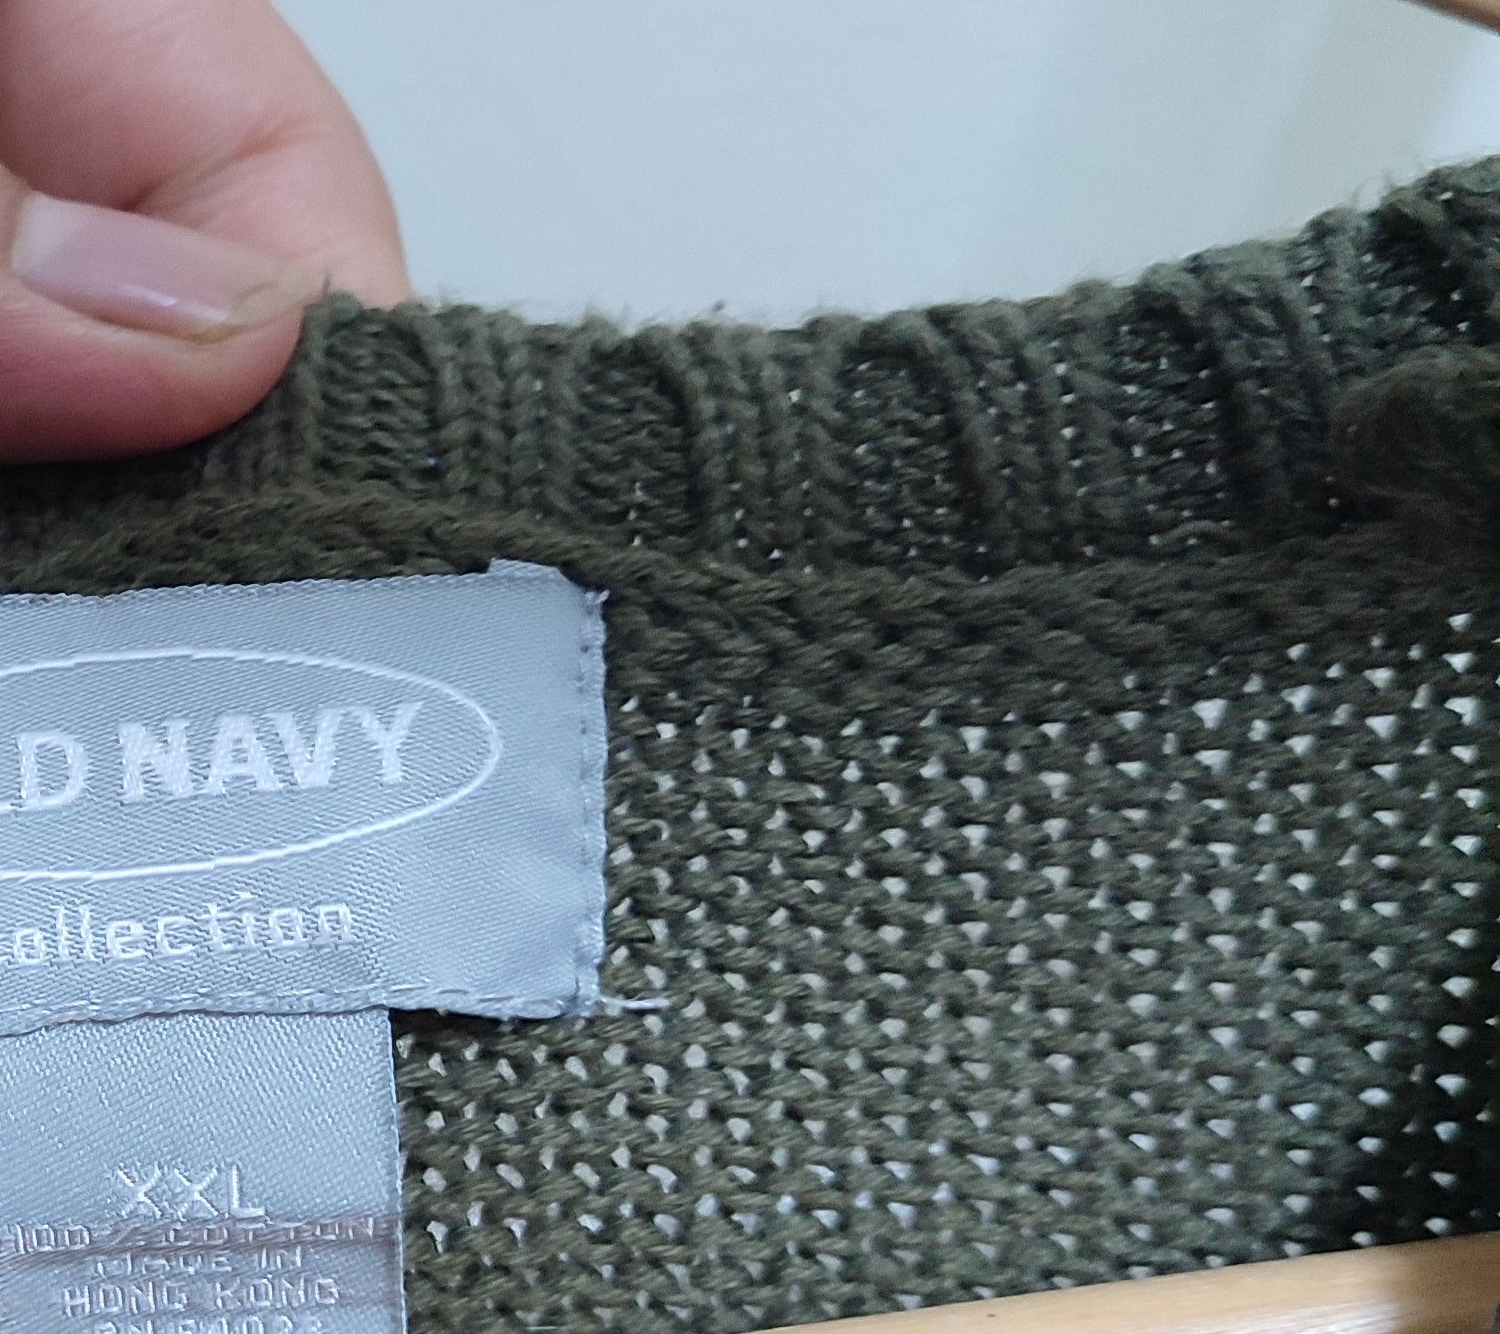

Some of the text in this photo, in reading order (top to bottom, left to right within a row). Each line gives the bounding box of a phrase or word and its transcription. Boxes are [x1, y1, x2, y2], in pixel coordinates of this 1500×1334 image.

[117, 701, 424, 803] NAVY
[113, 1162, 267, 1221] XXL
[260, 1244, 303, 1270] IN
[62, 1275, 340, 1318] HONG KONG
